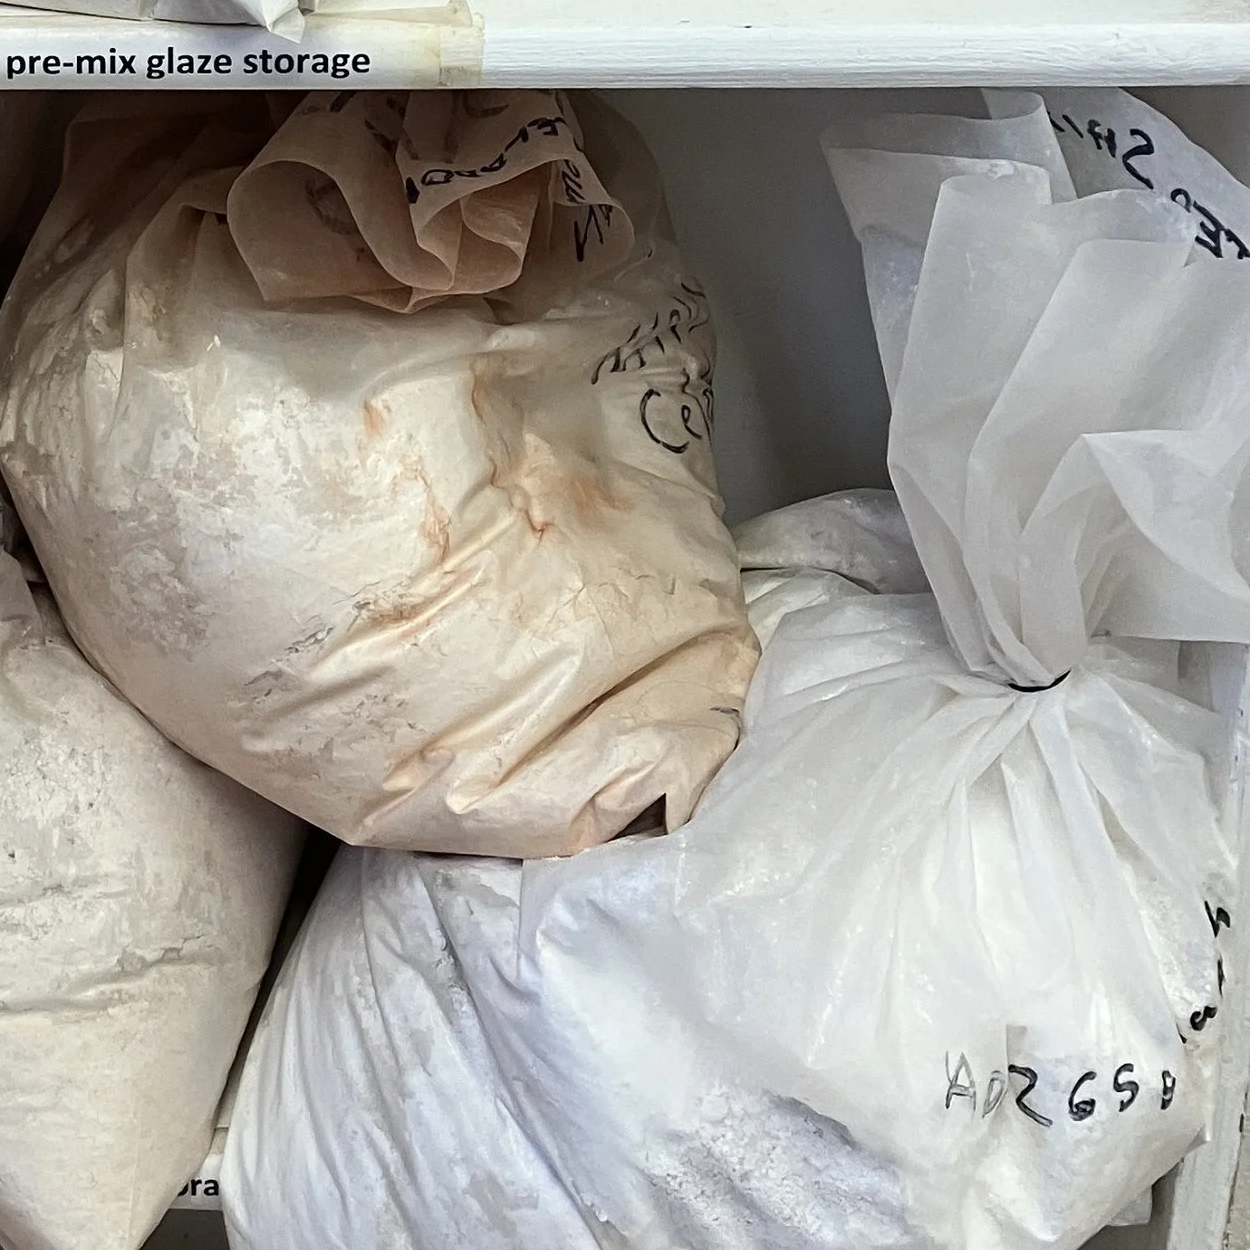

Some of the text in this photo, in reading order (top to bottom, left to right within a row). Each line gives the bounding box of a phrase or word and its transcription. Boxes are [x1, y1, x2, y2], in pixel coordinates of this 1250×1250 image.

[6, 47, 137, 79] pre-mix
[146, 46, 232, 79] glaze
[242, 49, 371, 79] storage
